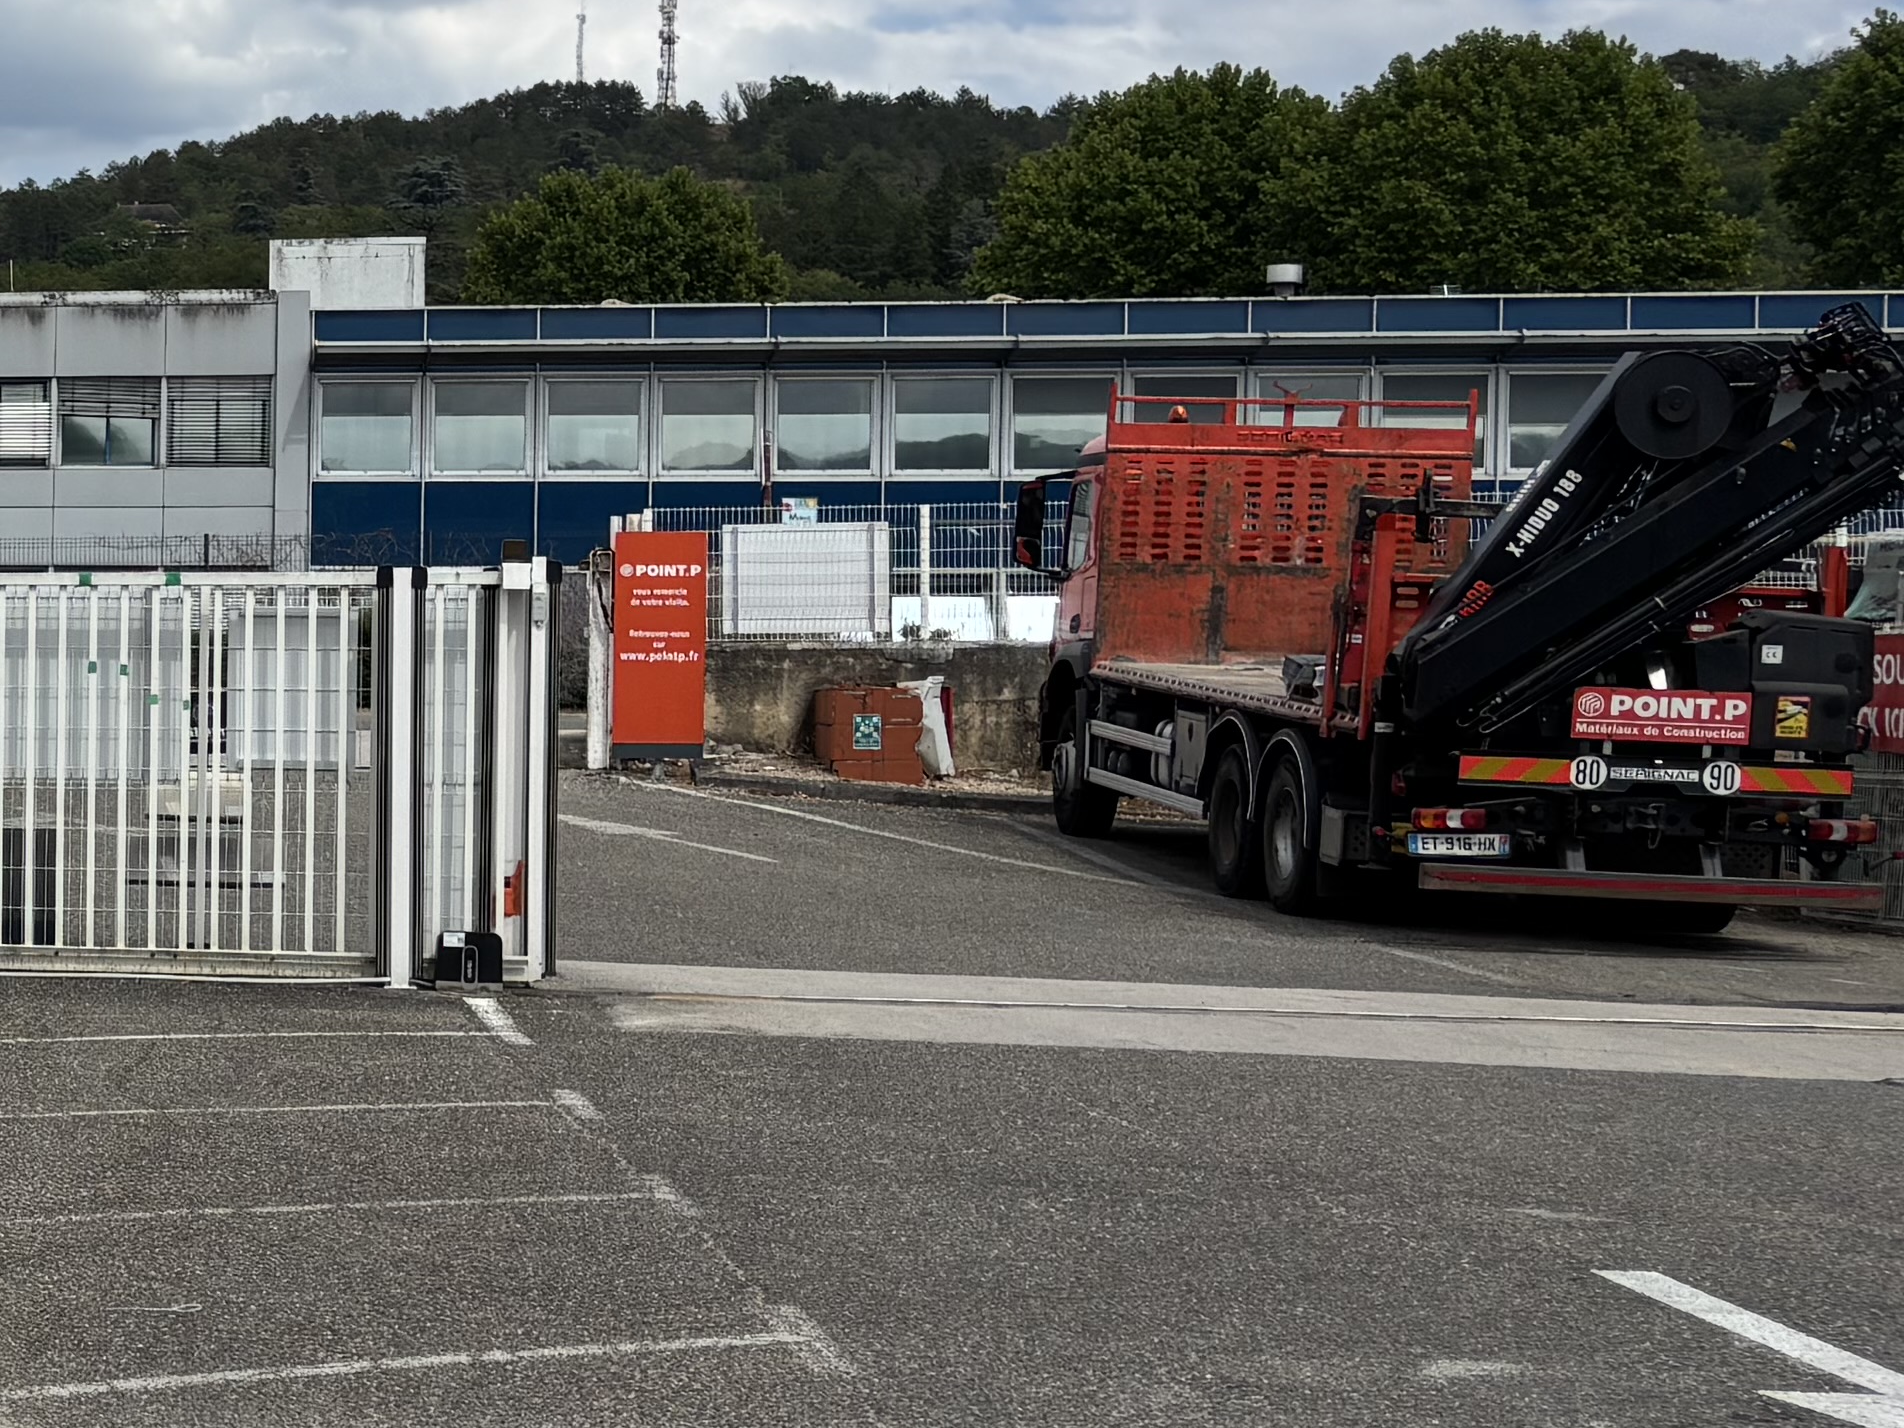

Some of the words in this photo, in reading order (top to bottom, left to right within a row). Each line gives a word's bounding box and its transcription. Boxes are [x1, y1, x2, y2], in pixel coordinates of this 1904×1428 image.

[1505, 498, 1560, 558] X-HIDUO
[1552, 469, 1583, 498] 188
[635, 564, 702, 577] POINT.P
[1610, 694, 1747, 721] POINT.P
[1643, 725, 1659, 736] de
[1663, 726, 1745, 739] Construction
[1575, 759, 1600, 785] 80
[1709, 764, 1735, 790] 90
